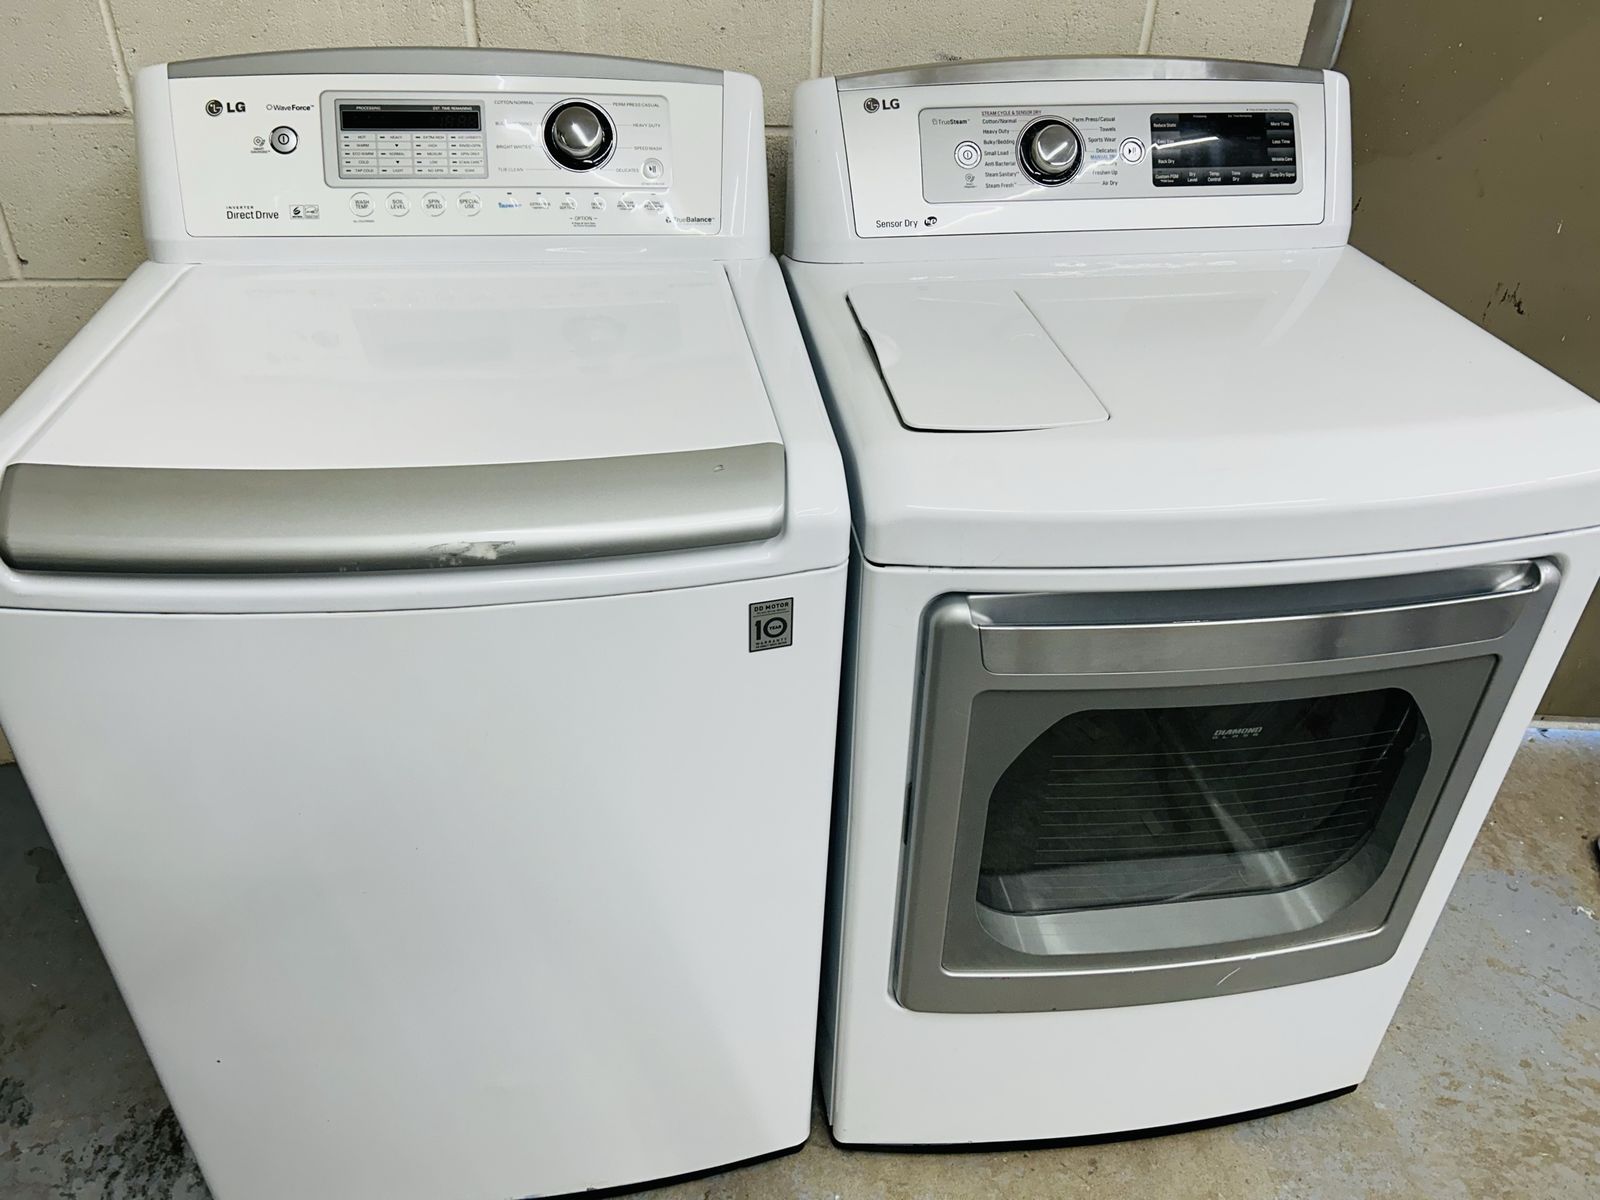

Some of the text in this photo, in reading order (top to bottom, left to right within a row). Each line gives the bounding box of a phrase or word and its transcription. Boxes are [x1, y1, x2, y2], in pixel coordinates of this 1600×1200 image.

[226, 101, 246, 113] LG
[882, 98, 900, 110] LG
[226, 210, 279, 219] Direct Drive
[875, 219, 903, 229] Sensor
[904, 218, 919, 229] Dry
[765, 601, 789, 610] MOTOR
[755, 616, 788, 641] 10
[1213, 726, 1263, 736] DIAMOND
